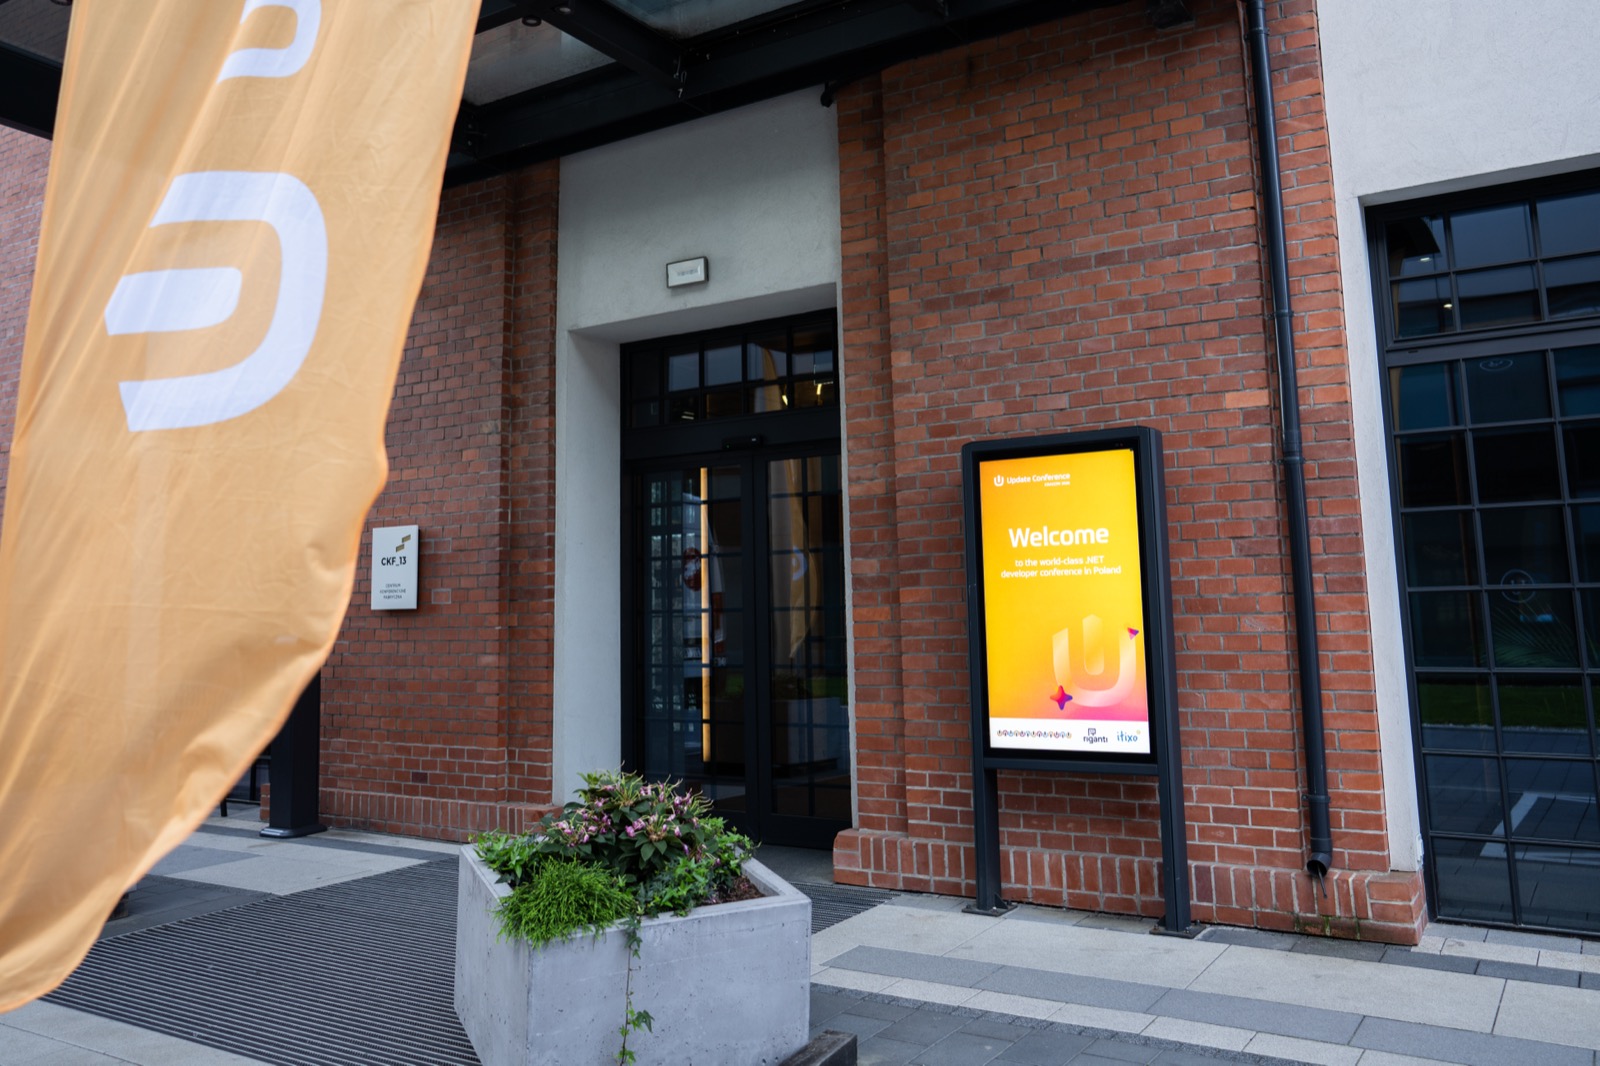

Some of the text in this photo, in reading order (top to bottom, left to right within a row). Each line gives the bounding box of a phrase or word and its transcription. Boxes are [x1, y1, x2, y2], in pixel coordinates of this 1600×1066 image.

[1006, 473, 1071, 485] Update Conference
[1008, 526, 1109, 548] Welcome
[1015, 555, 1105, 567] to the world-class .NET
[1001, 565, 1122, 579] developer conference in Poland
[1117, 730, 1138, 742] itixo
